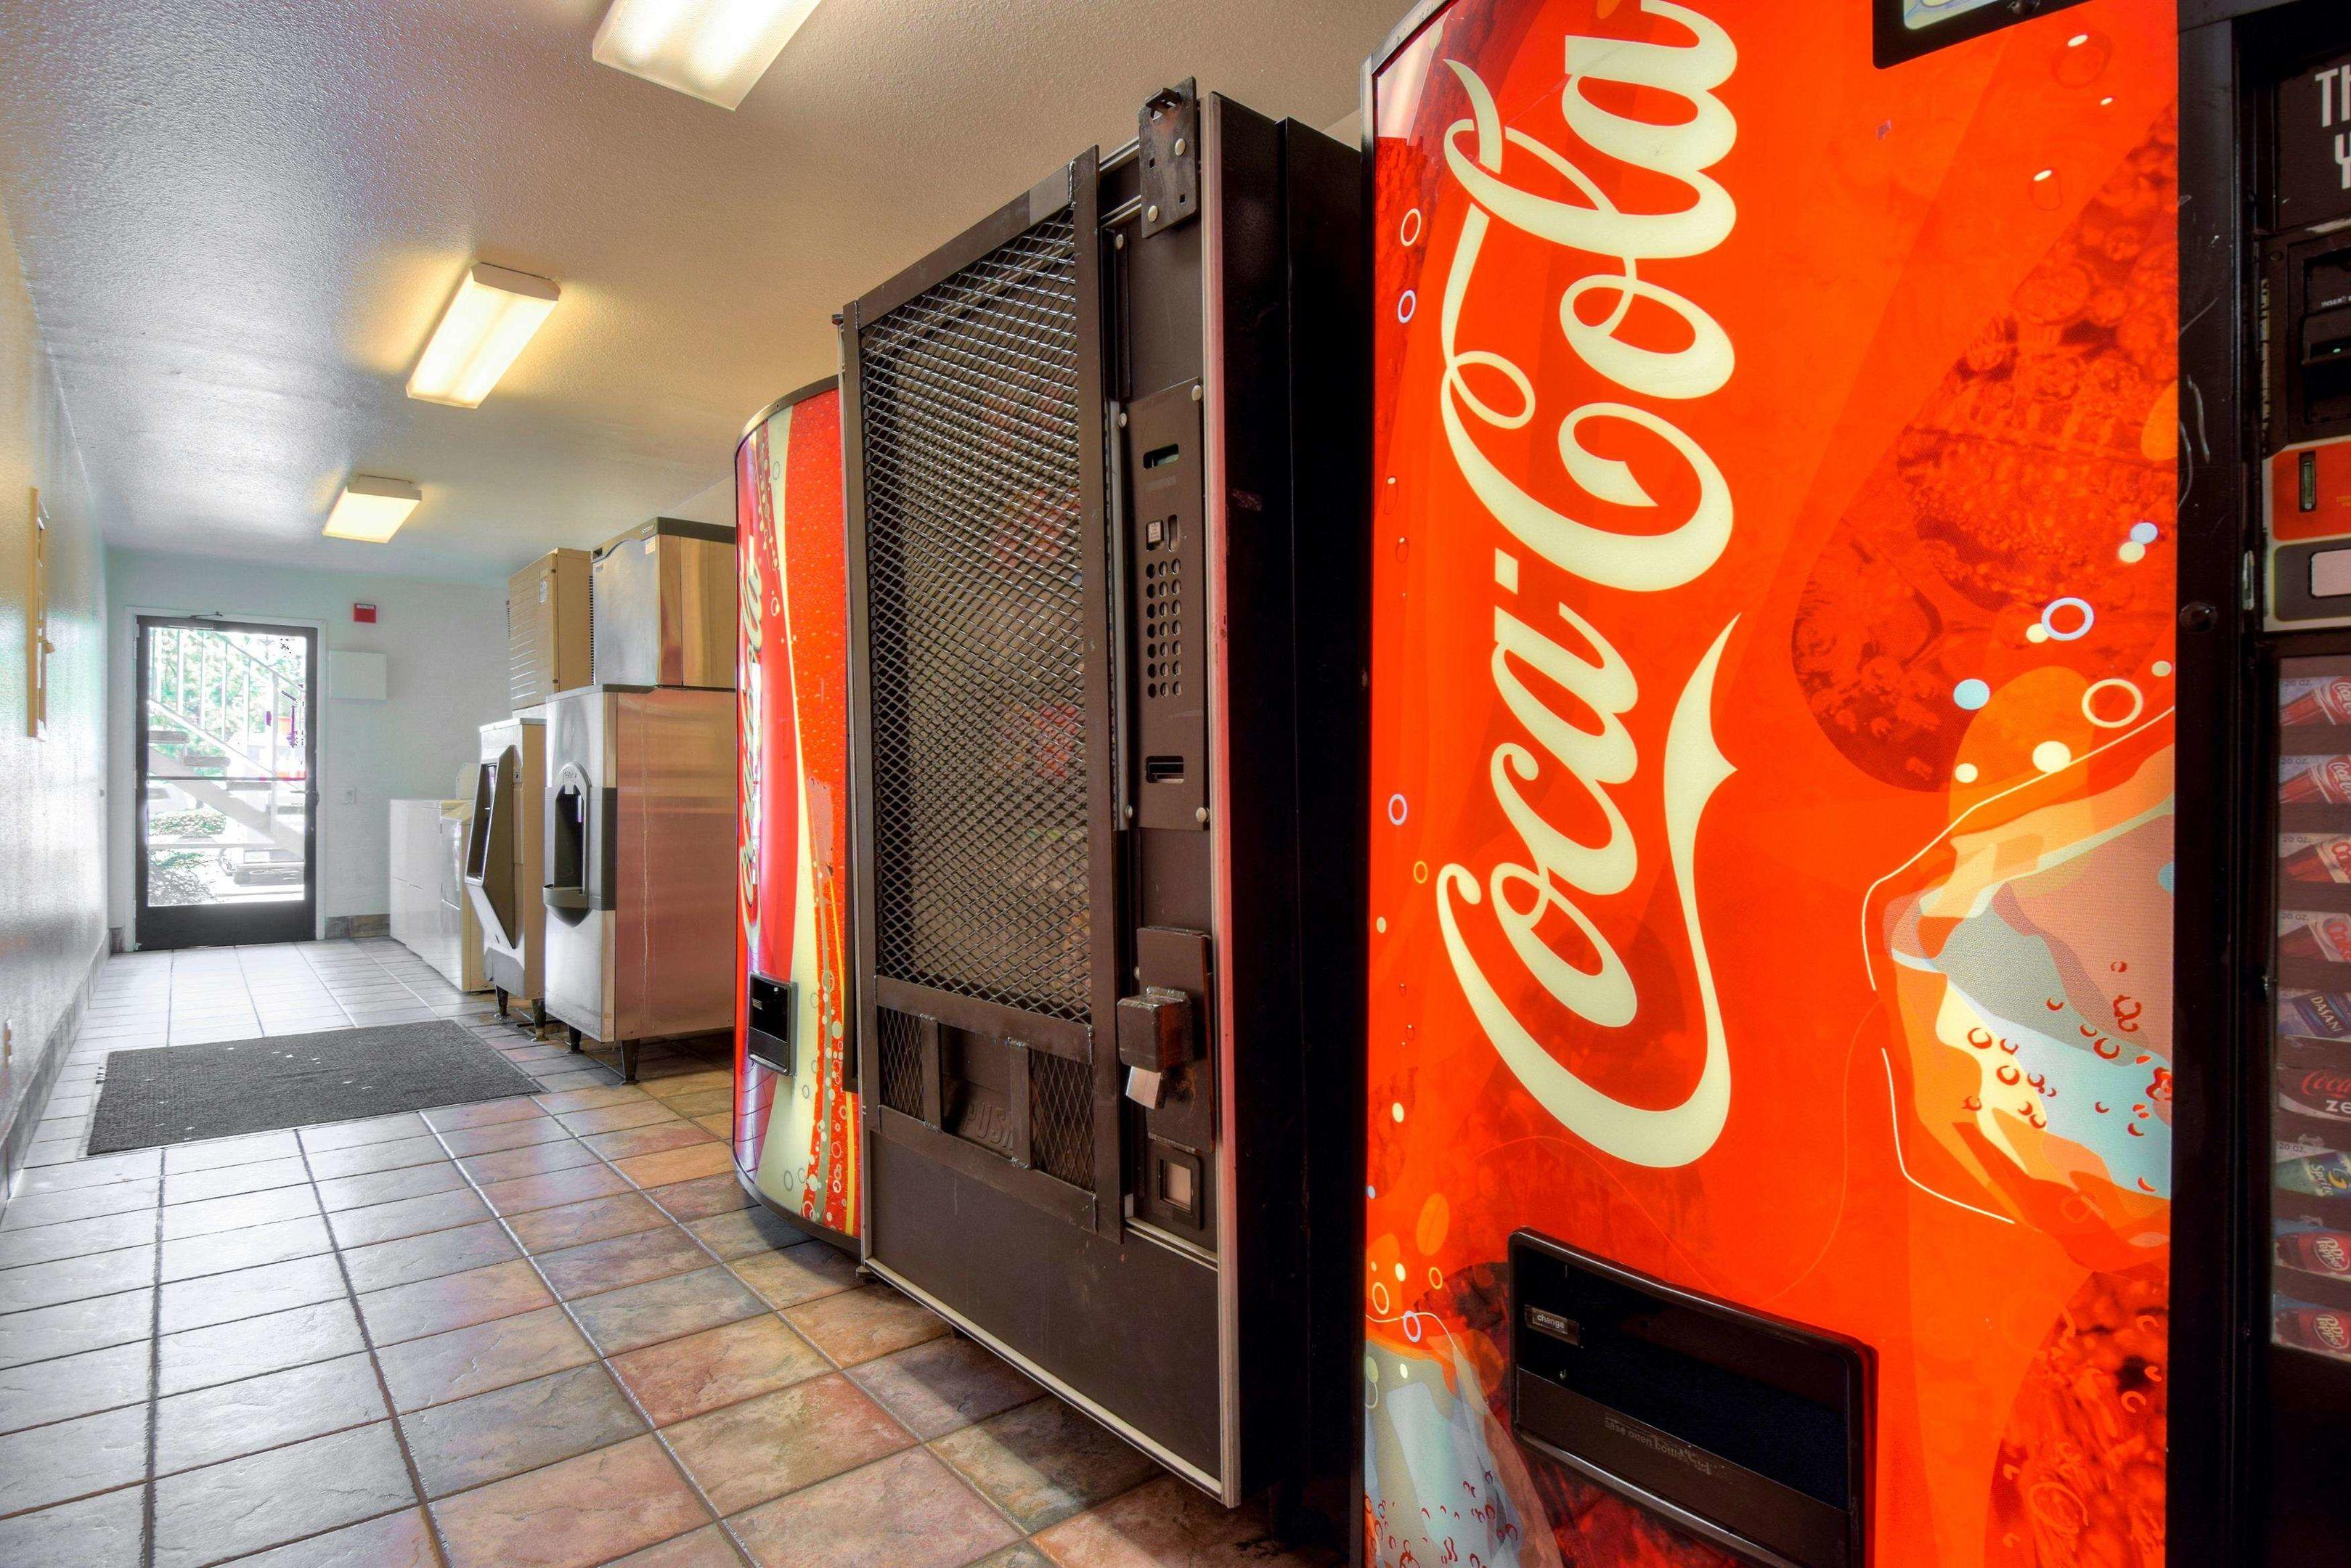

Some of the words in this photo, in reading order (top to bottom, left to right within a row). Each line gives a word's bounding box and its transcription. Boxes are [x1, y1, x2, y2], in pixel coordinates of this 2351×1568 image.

[1437, 0, 1741, 1168] Coca-Cola
[2310, 995, 2343, 1032] DASANI
[1537, 1314, 1565, 1328] change
